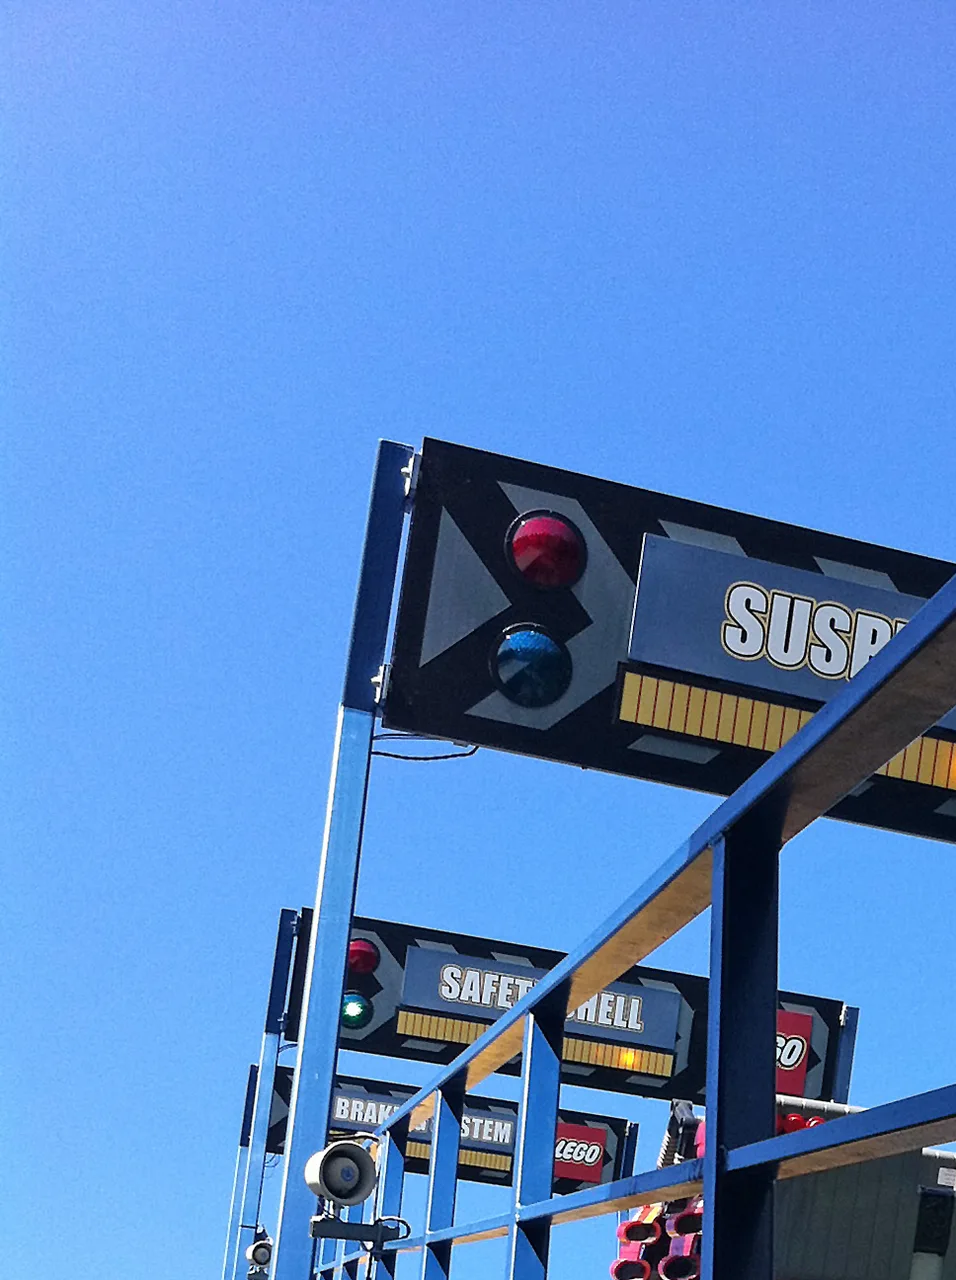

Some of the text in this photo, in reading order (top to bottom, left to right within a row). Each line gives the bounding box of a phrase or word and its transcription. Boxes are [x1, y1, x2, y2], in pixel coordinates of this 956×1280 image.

[440, 965, 643, 1032] SAFET HELL
[334, 1096, 513, 1145] BRAK STEM
[554, 1138, 603, 1165] LEGO
